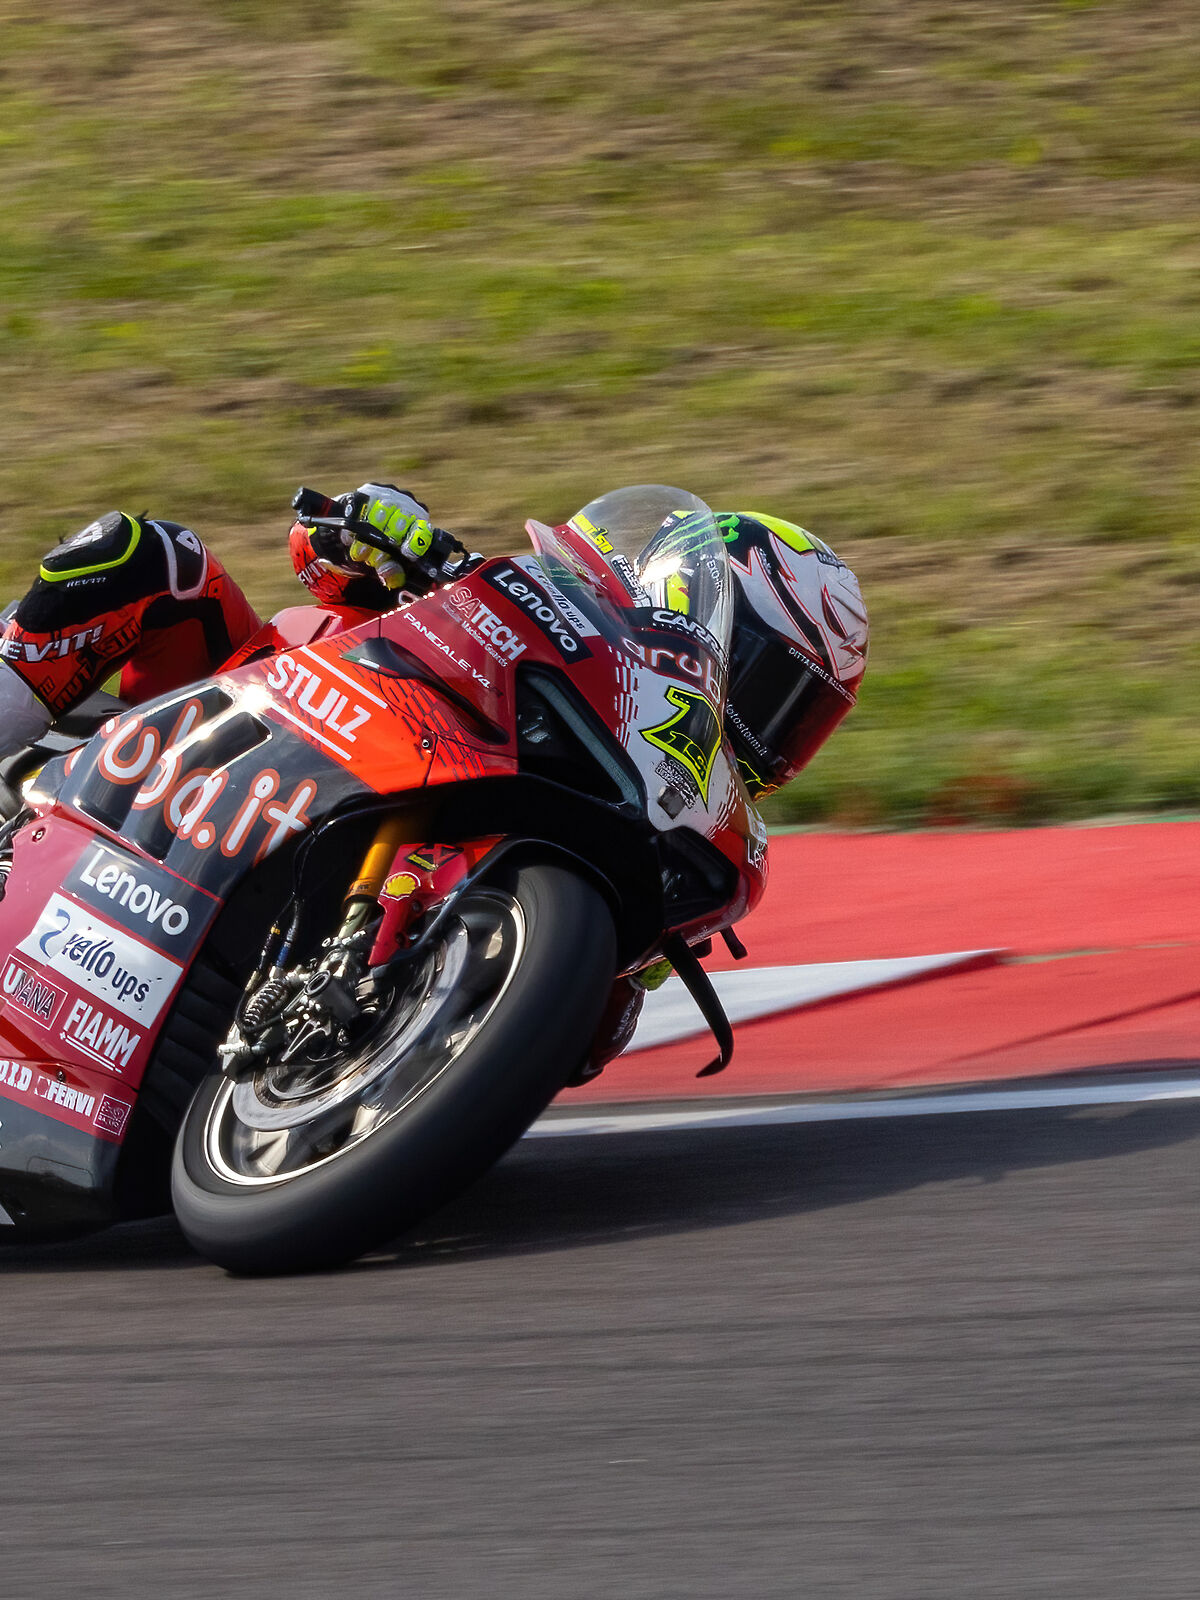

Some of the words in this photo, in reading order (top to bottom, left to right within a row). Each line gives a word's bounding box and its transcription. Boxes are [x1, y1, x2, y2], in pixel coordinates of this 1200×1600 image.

[449, 587, 527, 661] SATECH
[493, 569, 577, 652] Lenovo
[472, 668, 491, 689] V4
[788, 647, 809, 666] DITTA
[267, 654, 371, 743] STULZ
[79, 849, 189, 936] Lenovo
[111, 968, 149, 1003] ups
[63, 998, 142, 1067] FIAMM
[46, 1081, 96, 1117] FERVI
